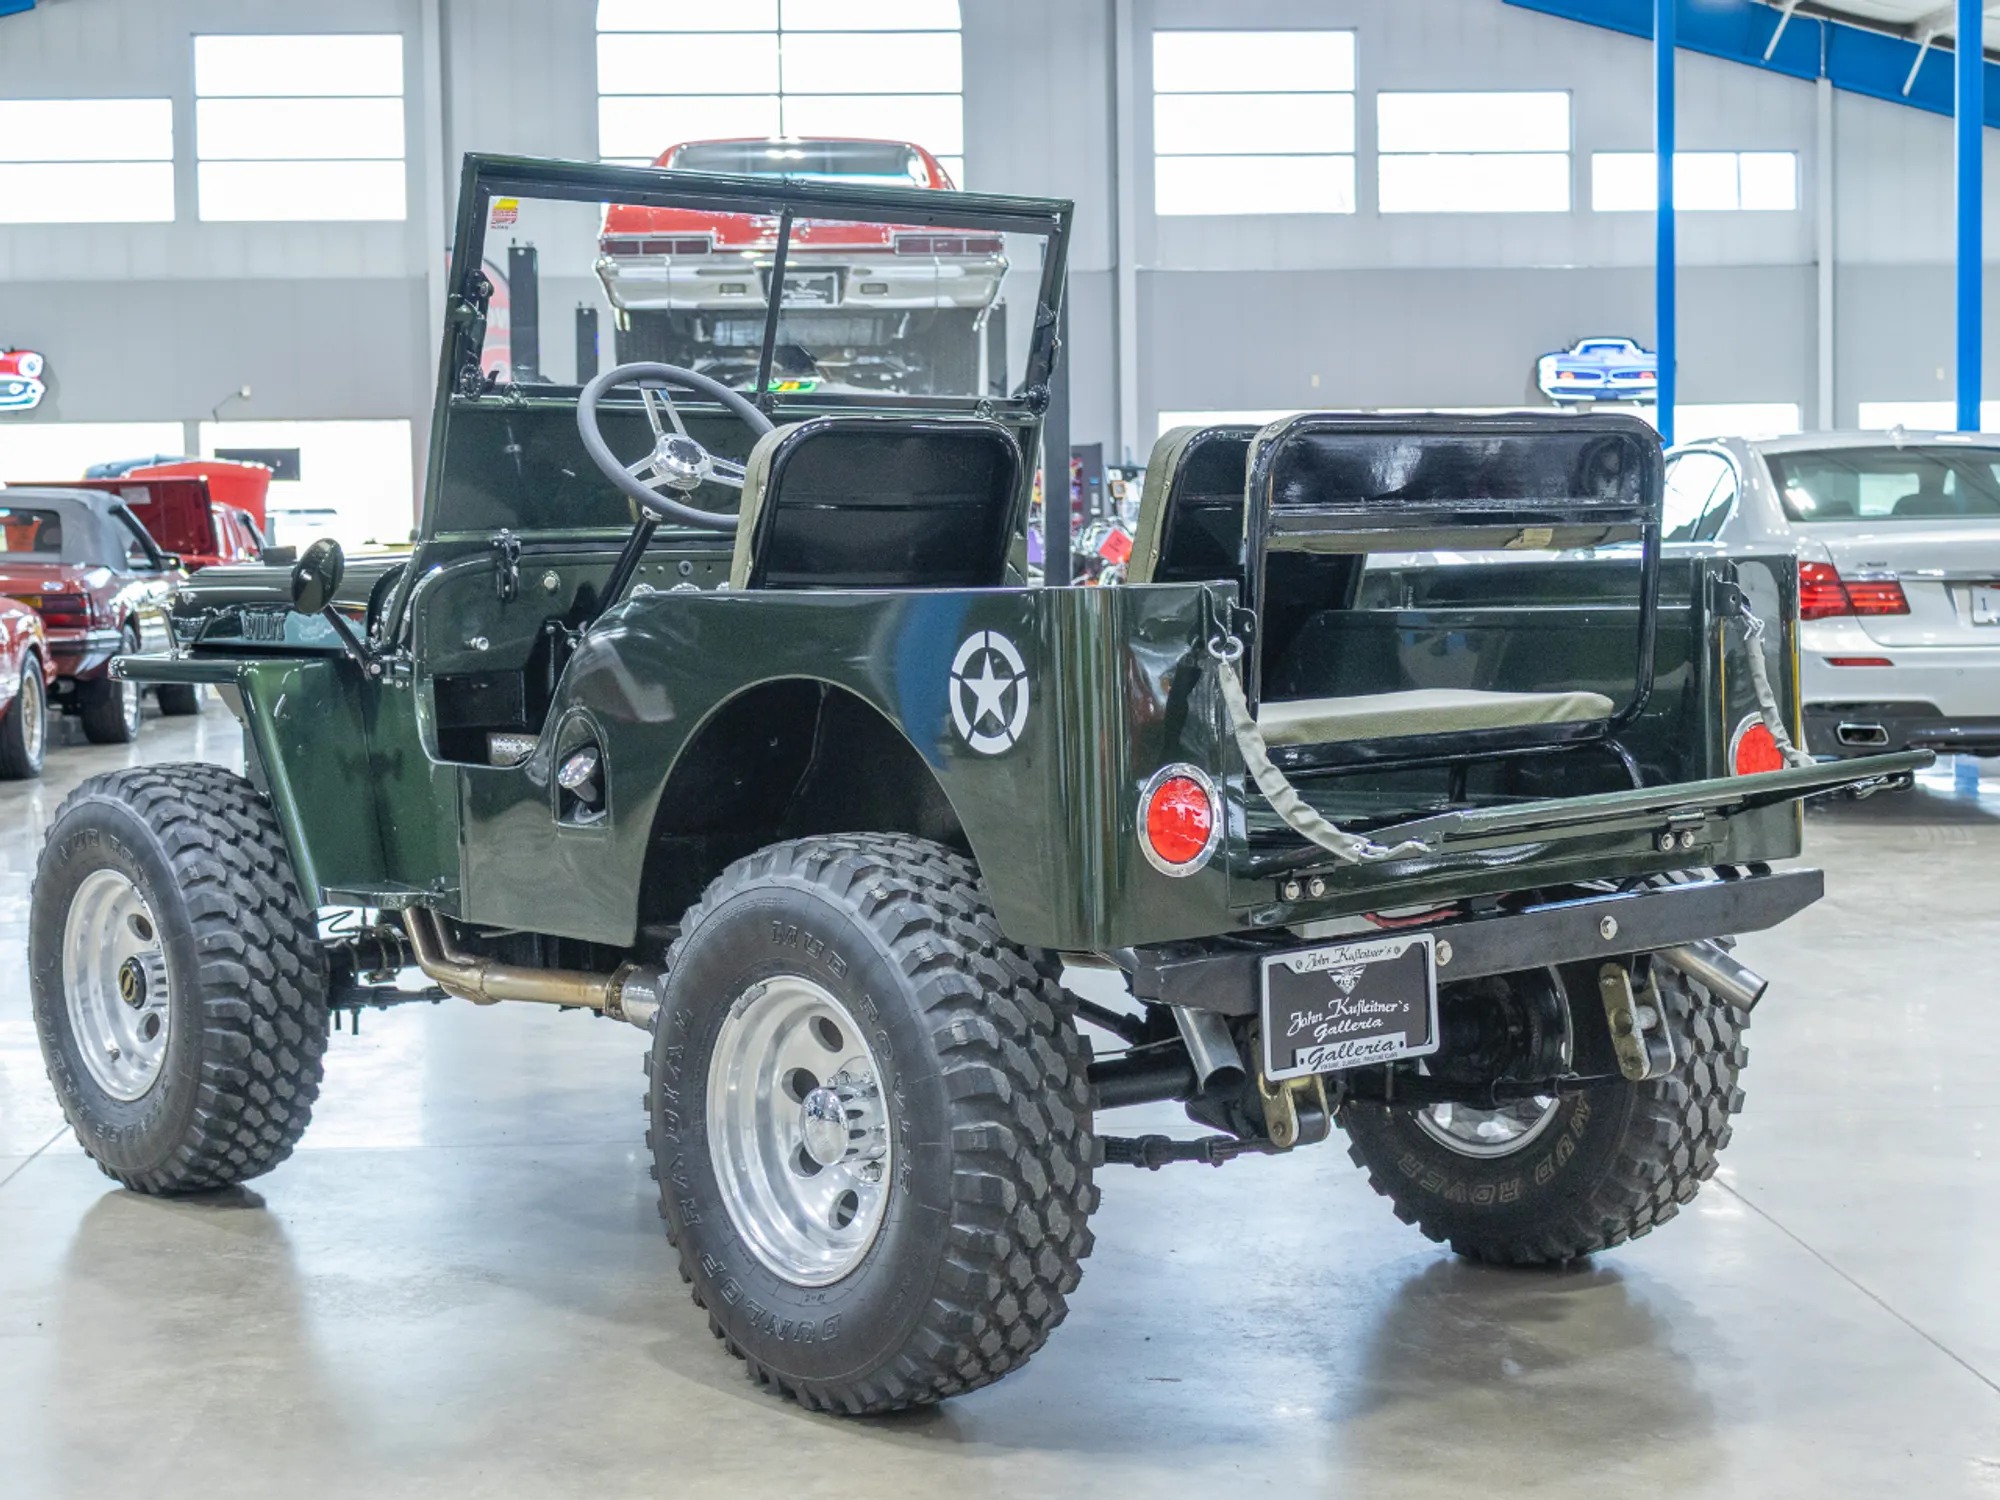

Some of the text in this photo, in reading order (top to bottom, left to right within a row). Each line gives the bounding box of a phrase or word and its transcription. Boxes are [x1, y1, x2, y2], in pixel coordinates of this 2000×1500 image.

[770, 919, 848, 980] MUD
[1305, 953, 1330, 972] John
[1286, 1011, 1323, 1037] John
[1313, 1018, 1384, 1044] Galleria
[1308, 1041, 1396, 1072] Galleria
[1397, 1089, 1592, 1206] MUD ROVER
[702, 1252, 843, 1344] DUNLOP
